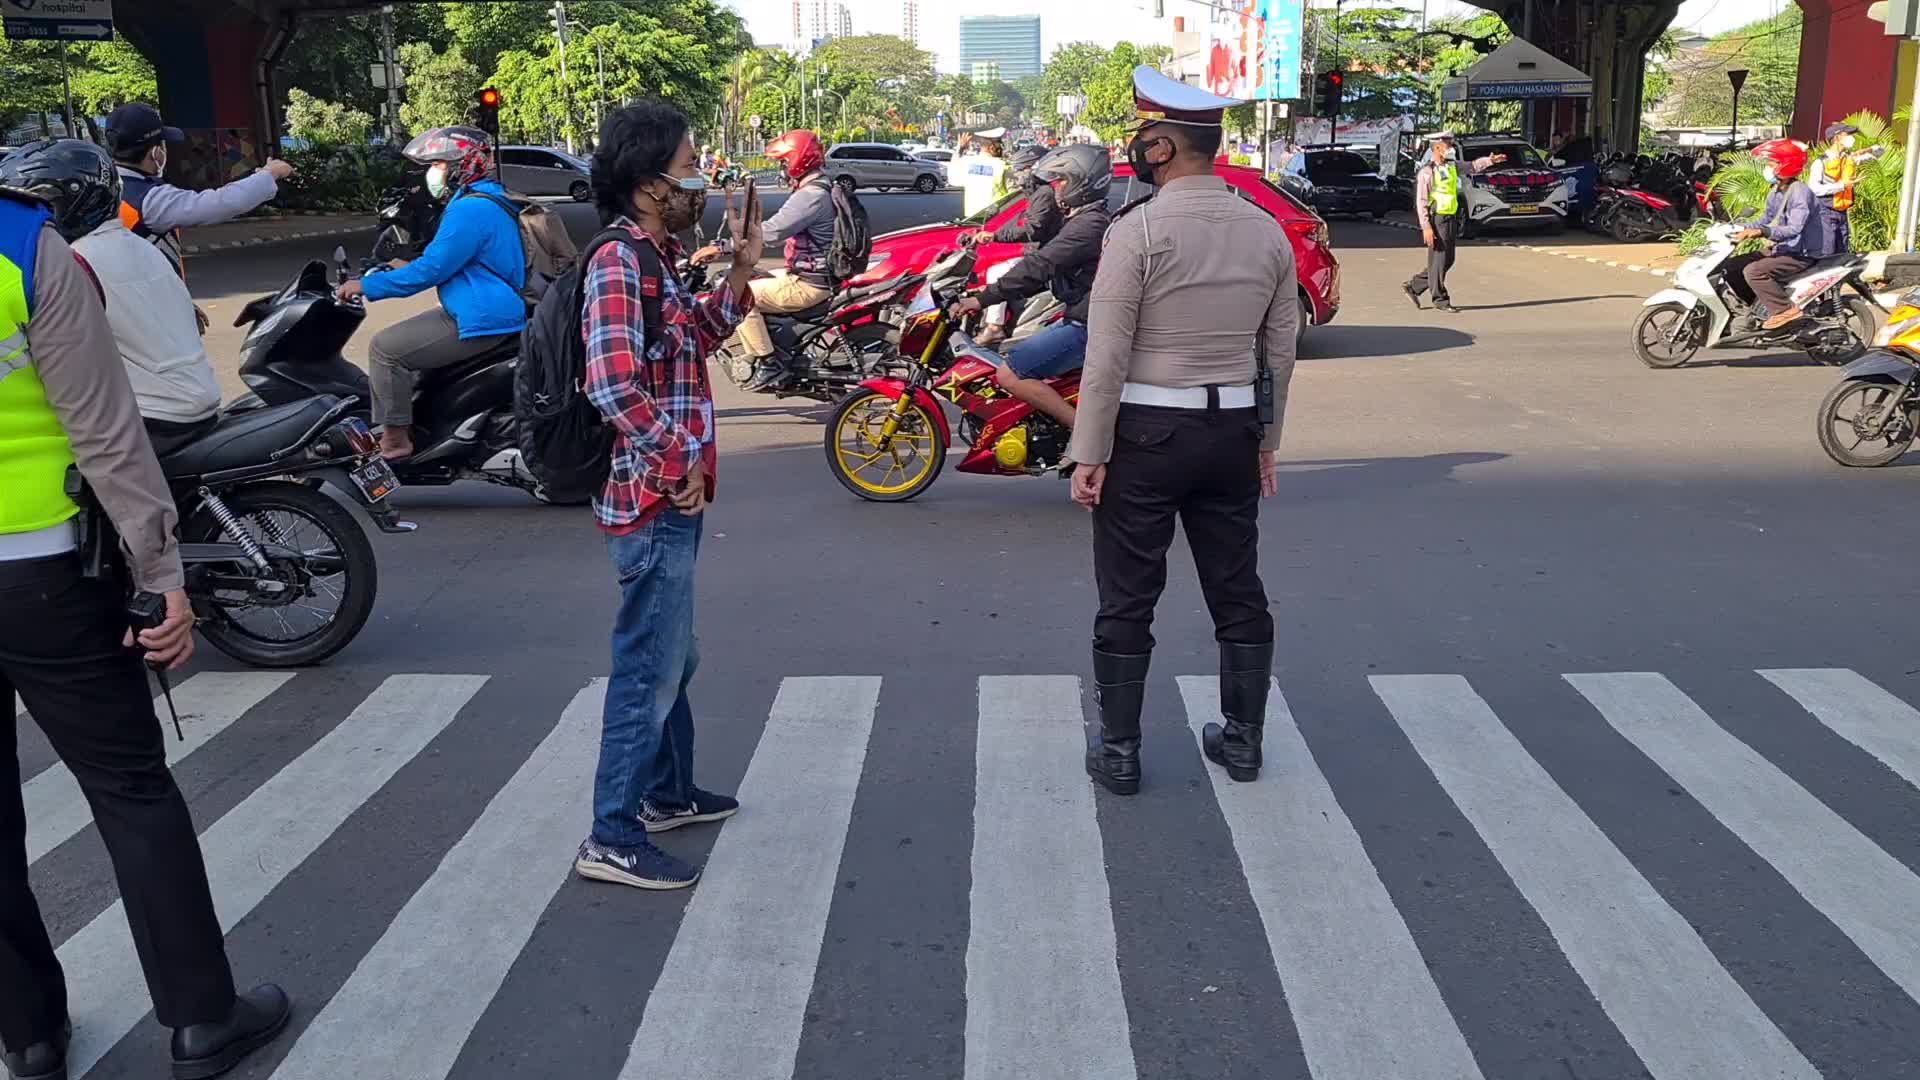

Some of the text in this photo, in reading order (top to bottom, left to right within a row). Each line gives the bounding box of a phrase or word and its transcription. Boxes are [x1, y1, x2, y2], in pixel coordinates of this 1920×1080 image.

[42, 3, 86, 13] hospital
[1480, 86, 1495, 95] POS
[1496, 85, 1524, 94] PANTAU
[1525, 84, 1560, 93] HASANAH
